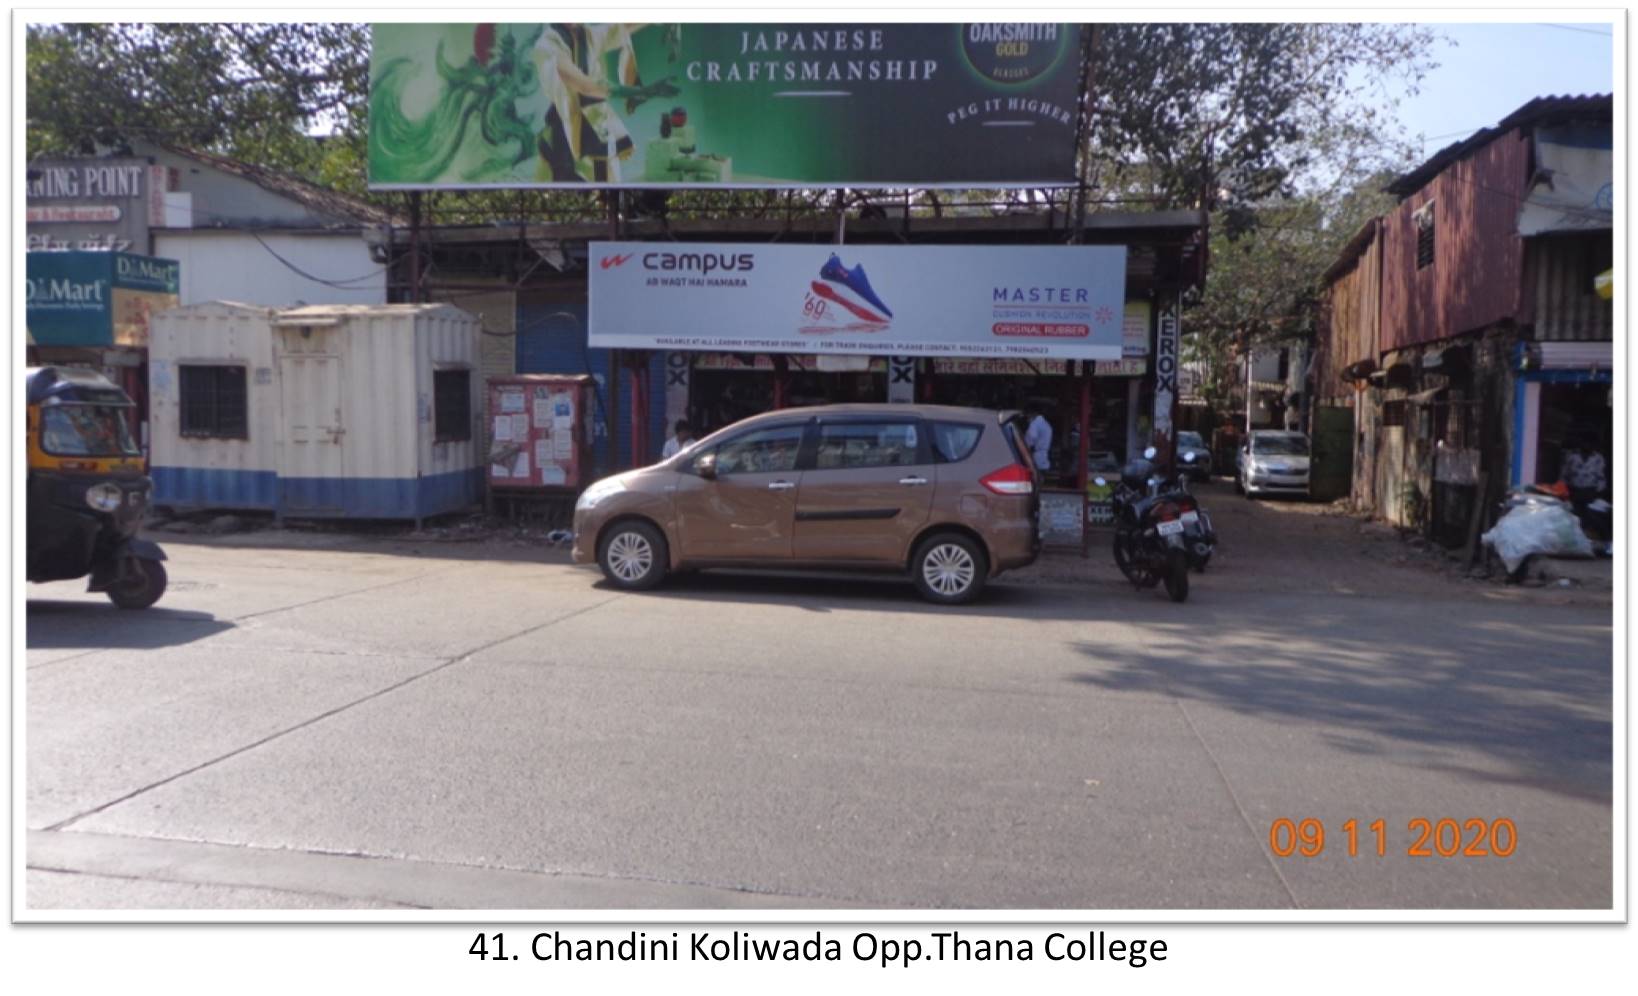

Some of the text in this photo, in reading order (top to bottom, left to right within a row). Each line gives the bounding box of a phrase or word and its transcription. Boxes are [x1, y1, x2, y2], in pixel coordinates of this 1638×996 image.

[741, 30, 884, 54] JAPANESE
[969, 23, 1057, 42] OAKSMITH
[995, 41, 1029, 57] GOLD
[686, 60, 939, 82] CRAFTSMANSHIP
[947, 97, 1071, 124] PEG IT HIGHER
[85, 166, 142, 196] POINT
[643, 252, 754, 275] campus
[646, 277, 747, 288] AB WAQT HAI HAMARA
[993, 287, 1089, 302] MASTER
[995, 323, 1087, 336] ORIGINAL RUBBER
